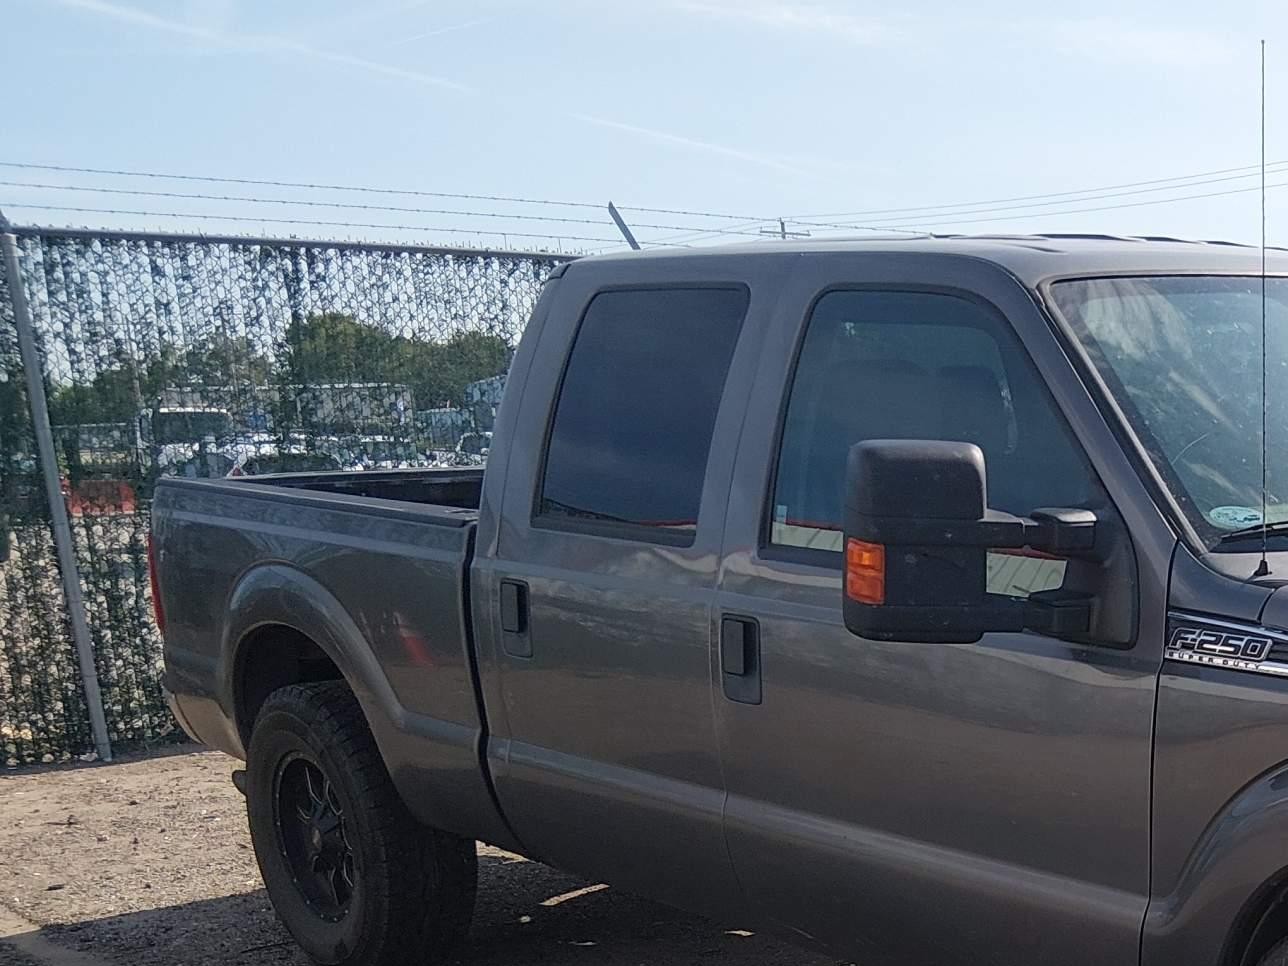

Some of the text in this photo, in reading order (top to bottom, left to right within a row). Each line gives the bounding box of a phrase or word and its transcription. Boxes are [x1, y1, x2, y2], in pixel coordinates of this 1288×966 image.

[1169, 627, 1270, 660] F-250
[1168, 651, 1260, 670] SUPER DUTY
